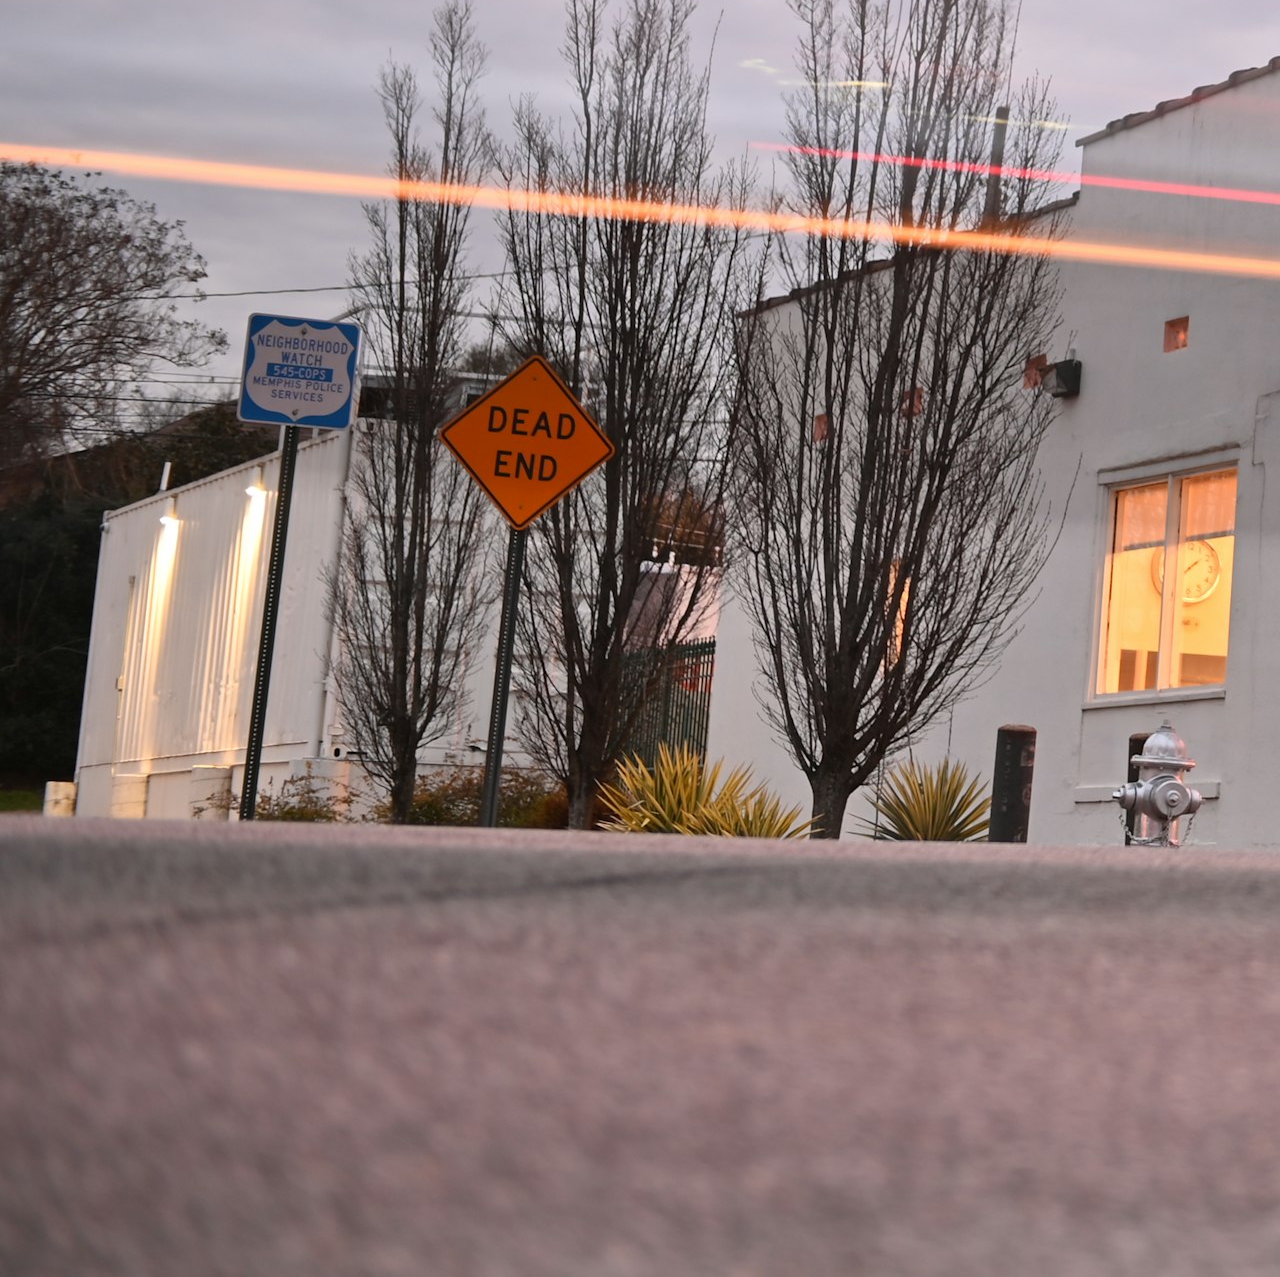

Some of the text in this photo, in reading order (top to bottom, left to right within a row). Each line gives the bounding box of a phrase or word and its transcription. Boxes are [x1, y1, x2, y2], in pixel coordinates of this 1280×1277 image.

[256, 334, 348, 355] NEIGHBORHOOD
[281, 351, 323, 367] WATCH
[273, 365, 326, 381] 545-COPS
[253, 376, 343, 394] MEMPHIS POLICE
[271, 389, 323, 402] SERVICES
[488, 405, 576, 440] DEAD
[494, 450, 558, 482] END
